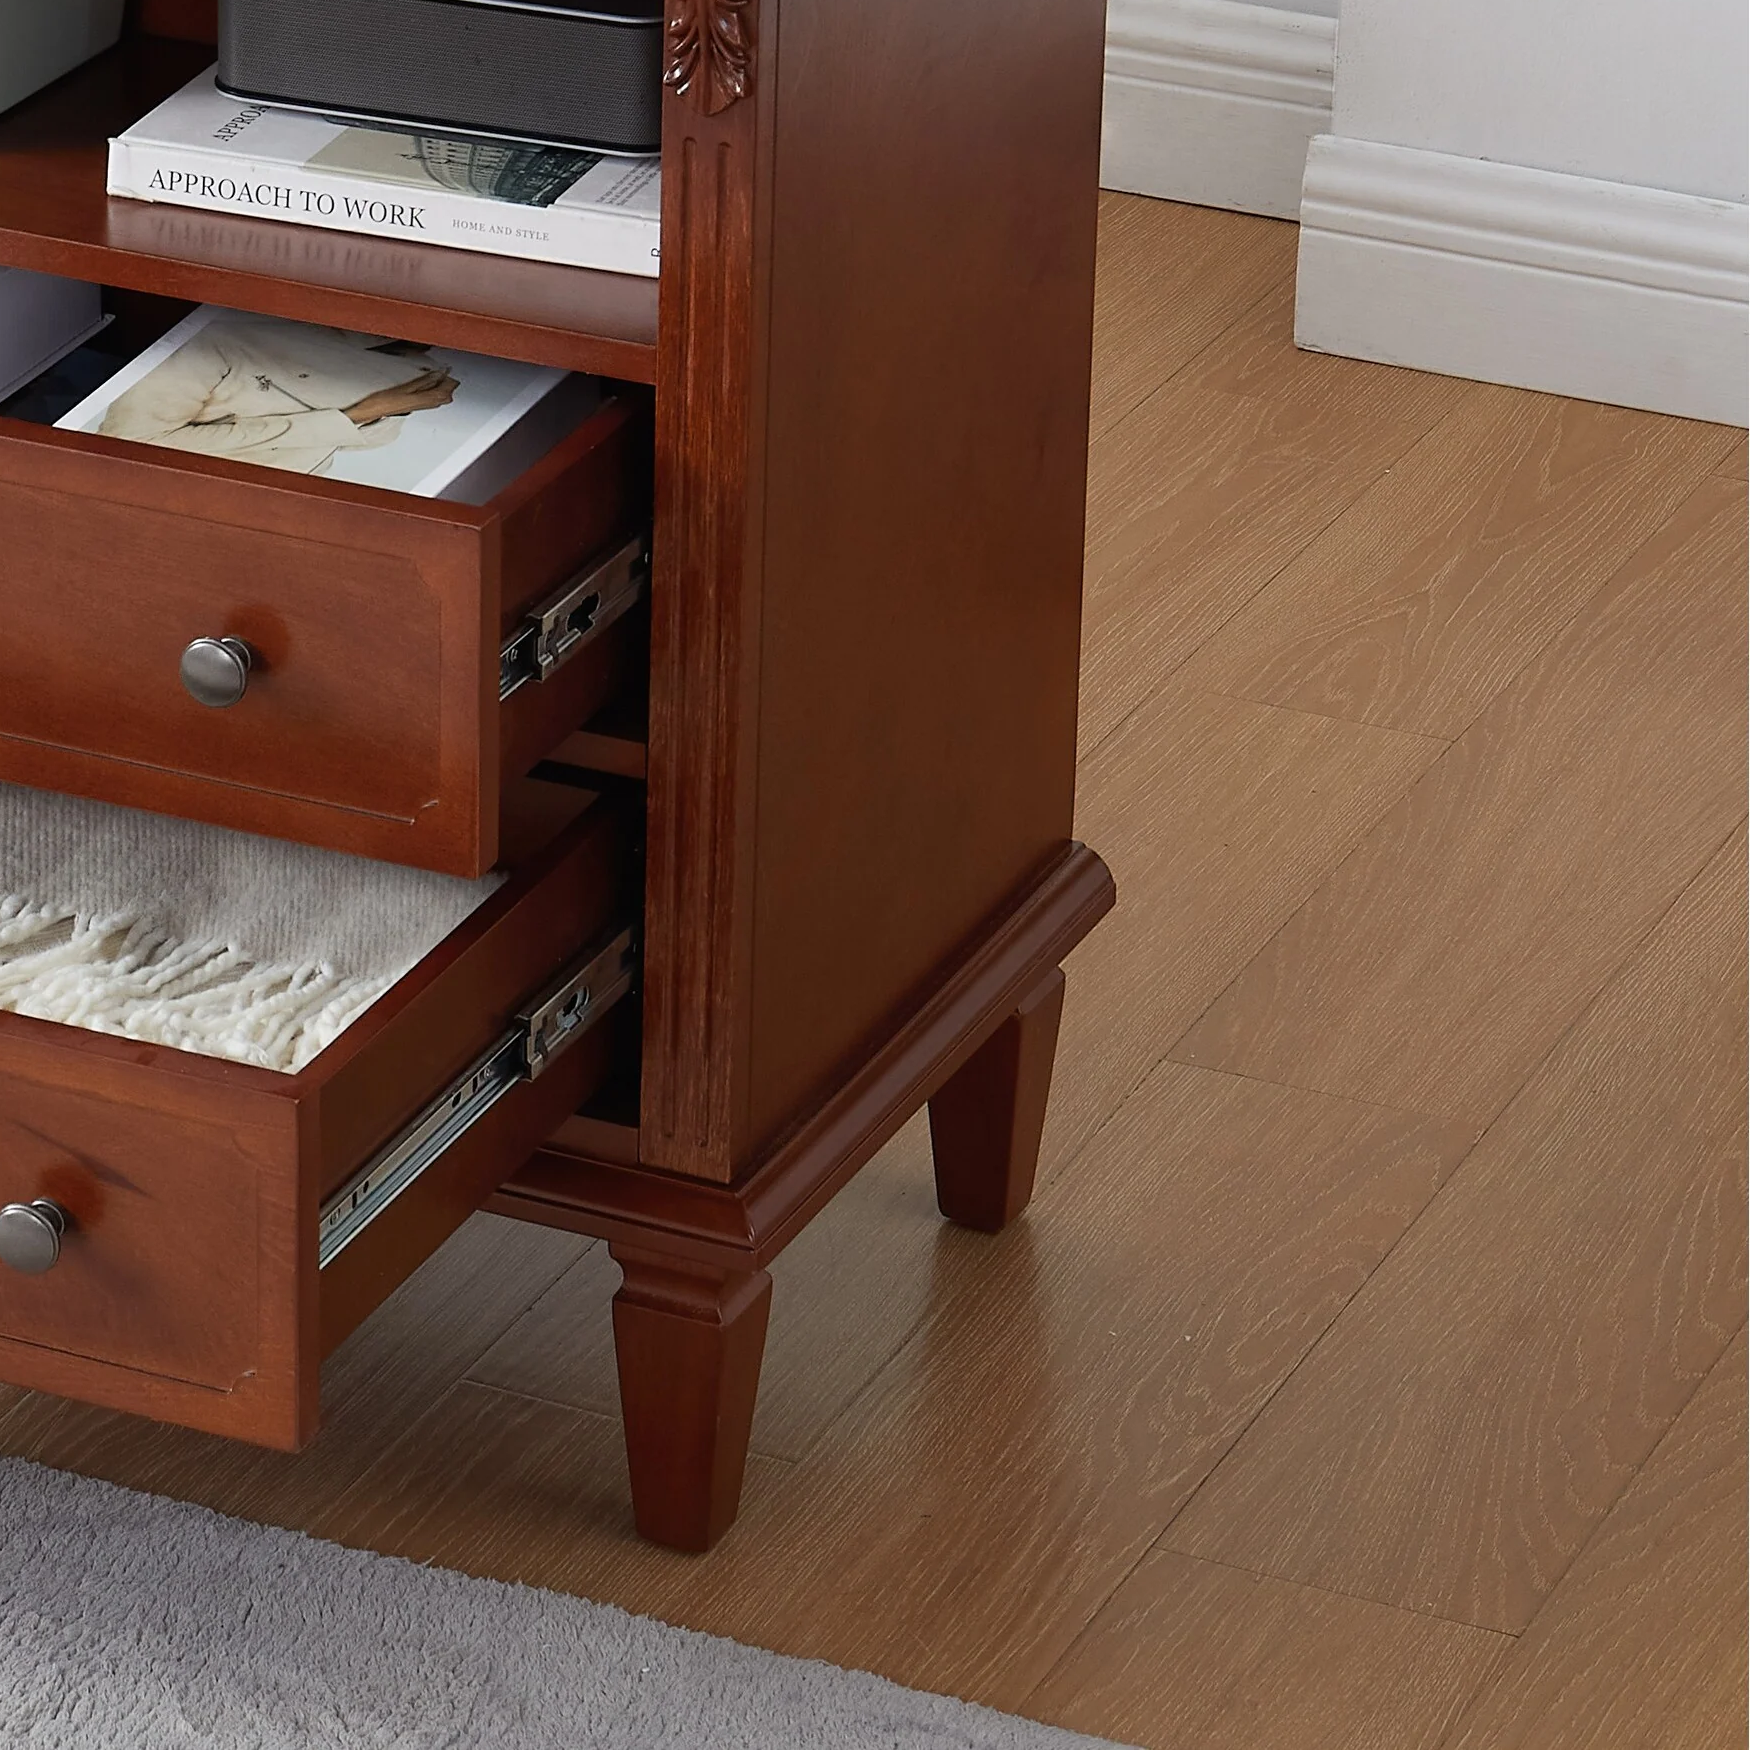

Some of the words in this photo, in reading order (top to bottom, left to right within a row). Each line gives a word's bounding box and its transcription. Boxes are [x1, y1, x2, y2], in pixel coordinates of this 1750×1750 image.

[149, 168, 291, 210] APPROACH
[299, 189, 336, 216] TO
[342, 196, 427, 230] WORK
[452, 218, 486, 233] HOME
[488, 224, 513, 237] AND
[515, 228, 550, 242] STYLE
